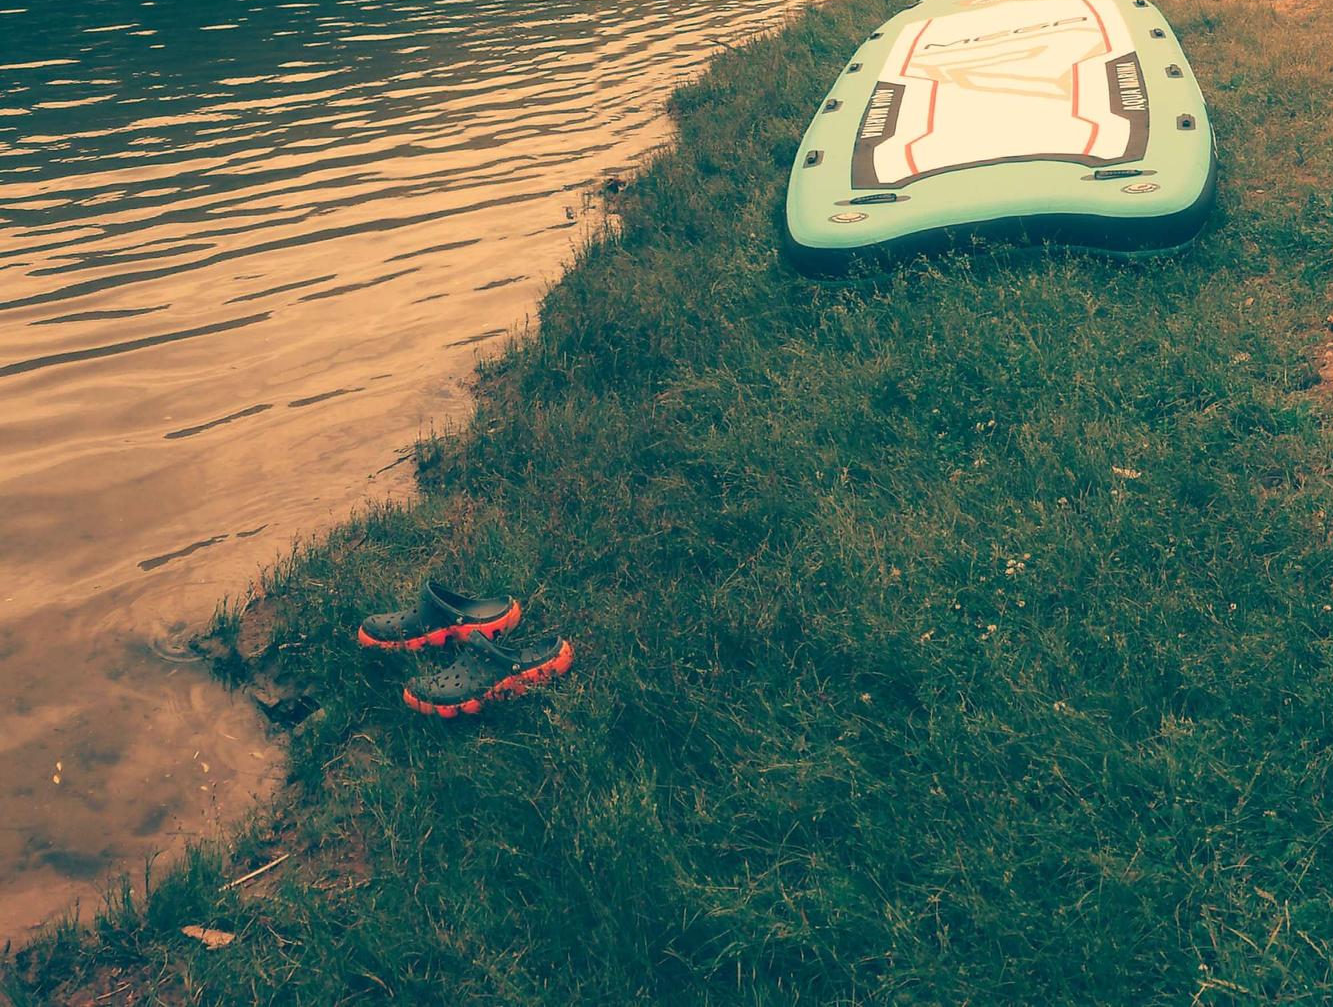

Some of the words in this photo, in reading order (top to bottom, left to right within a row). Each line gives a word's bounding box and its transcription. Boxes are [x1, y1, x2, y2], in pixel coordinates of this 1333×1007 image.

[1115, 62, 1140, 89] MARINA
[871, 89, 894, 108] AQUA
[1120, 89, 1147, 110] AQUA
[861, 108, 890, 139] MARINA
